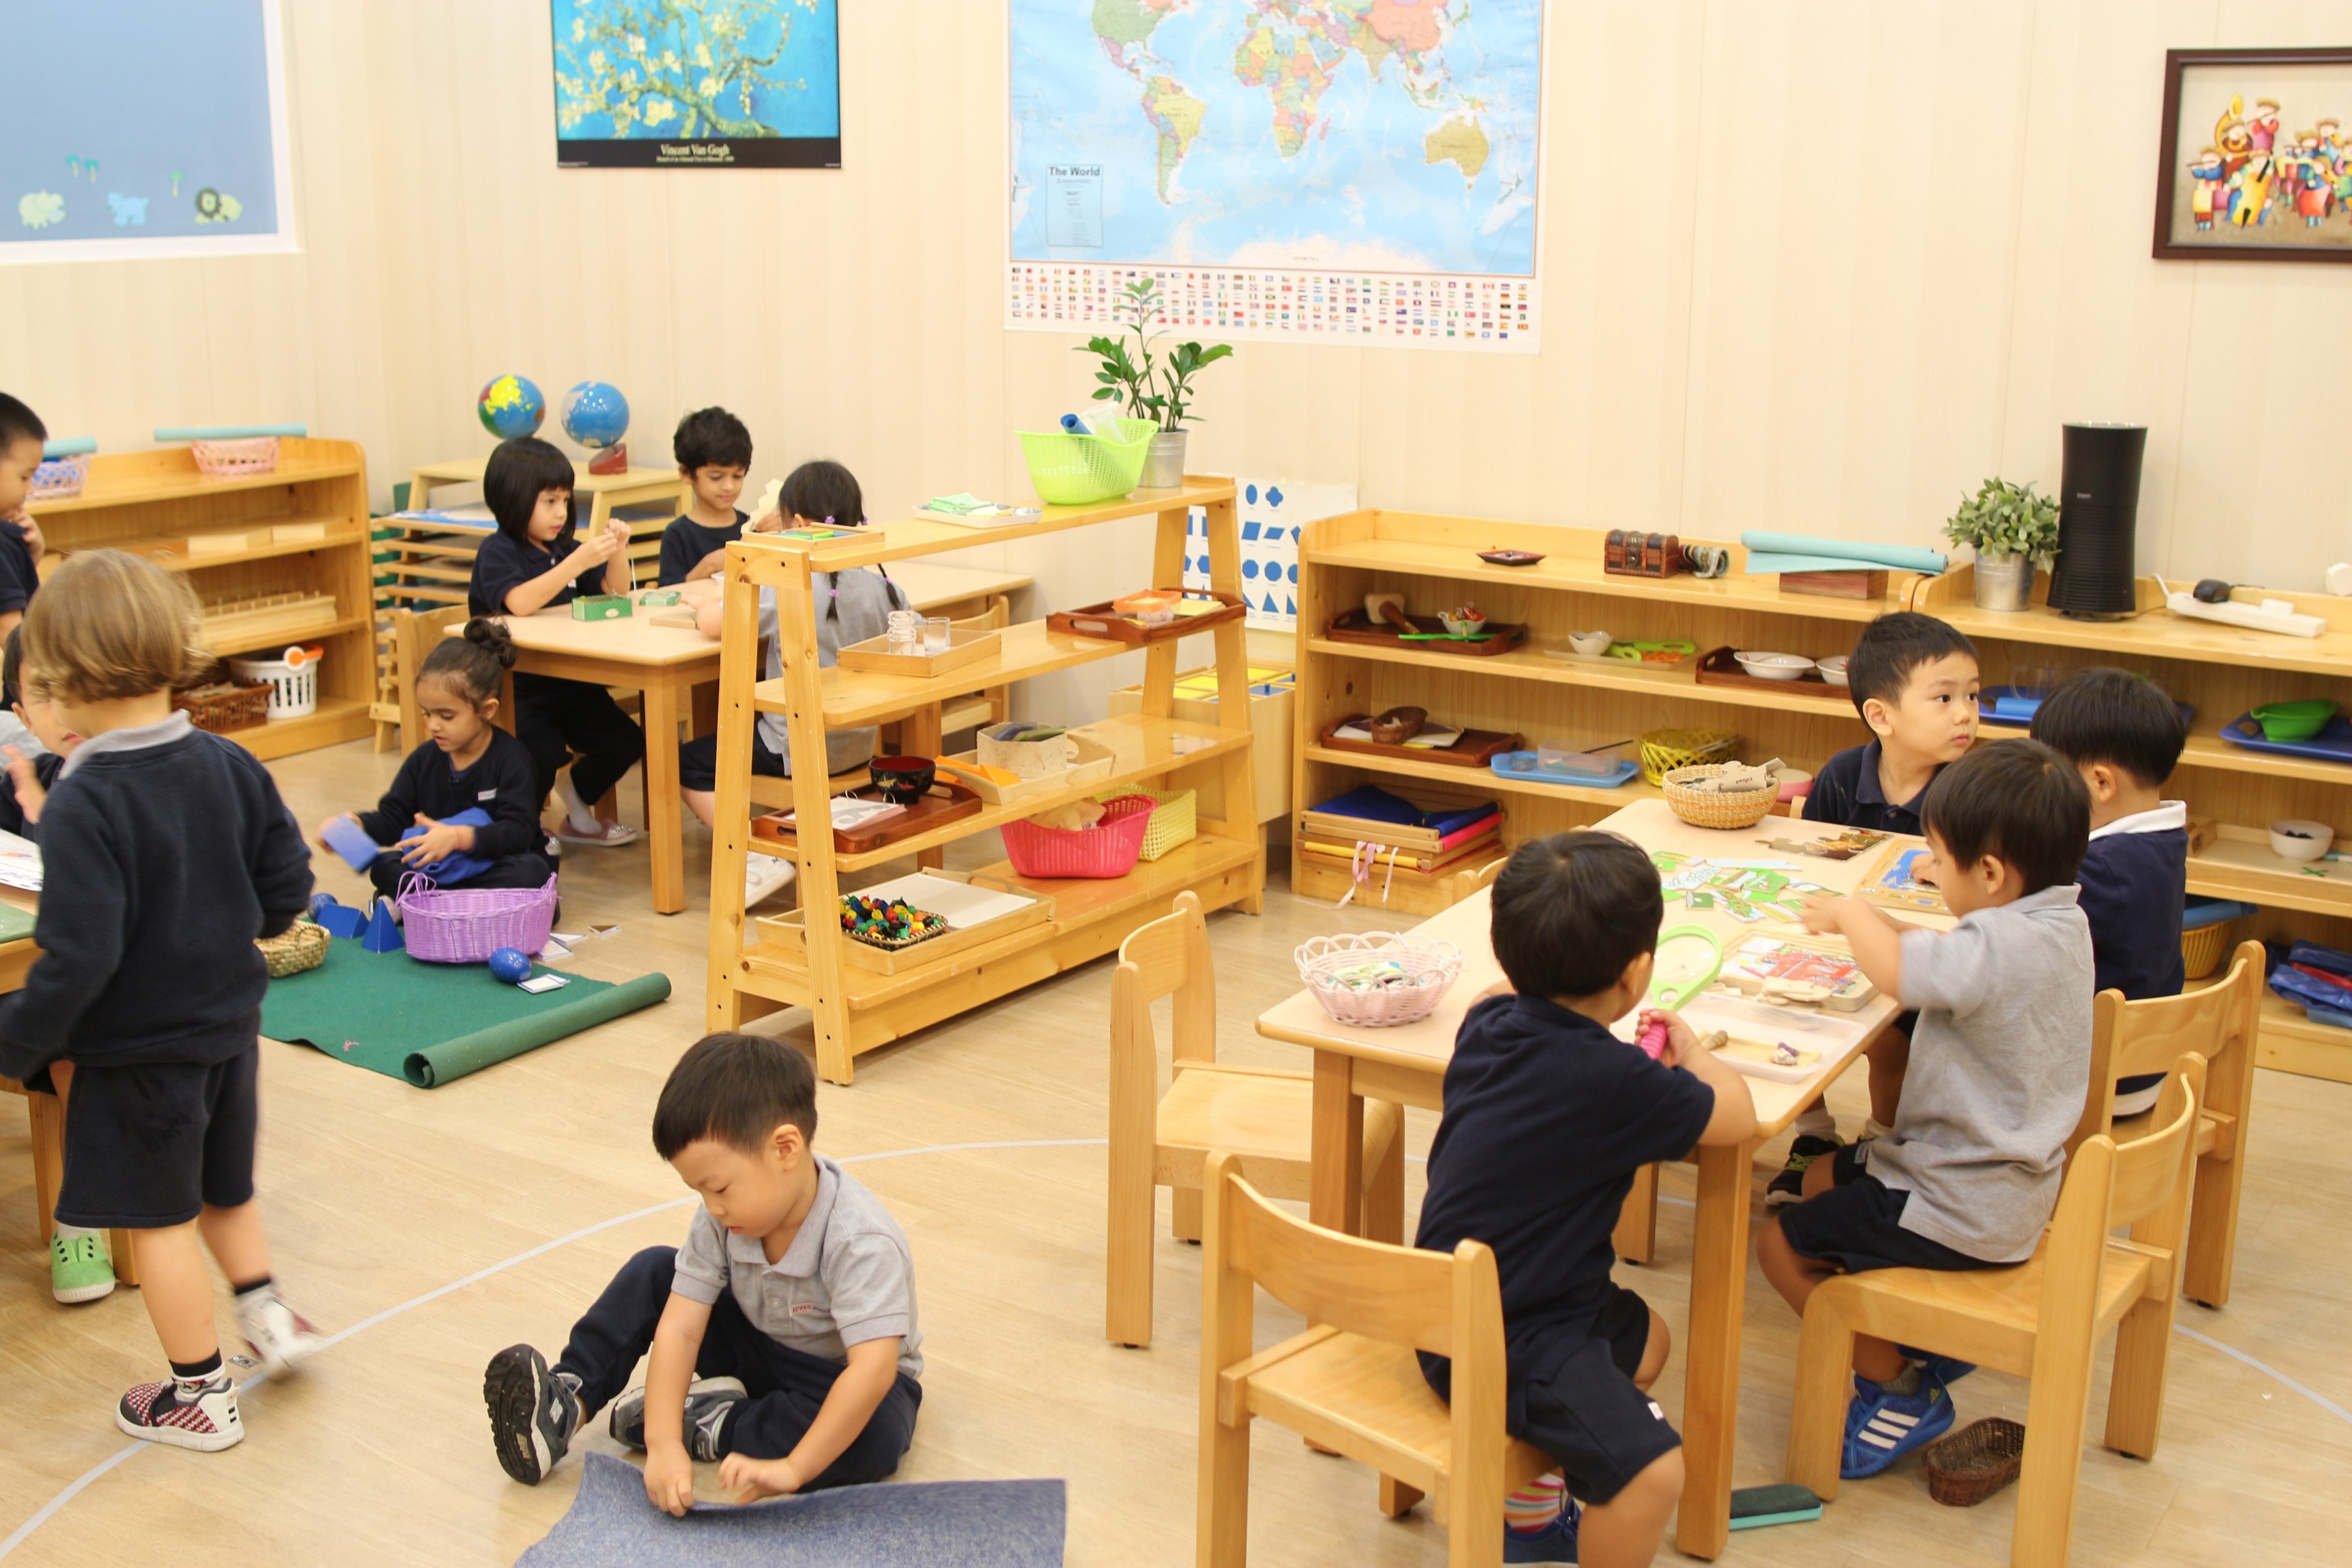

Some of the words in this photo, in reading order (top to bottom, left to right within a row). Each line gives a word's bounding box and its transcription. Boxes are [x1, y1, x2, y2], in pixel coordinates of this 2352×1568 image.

[660, 144, 690, 156] Vincent
[691, 144, 707, 156] Van
[708, 143, 730, 157] Gogh
[1049, 166, 1067, 175] The
[1070, 166, 1100, 176] World
